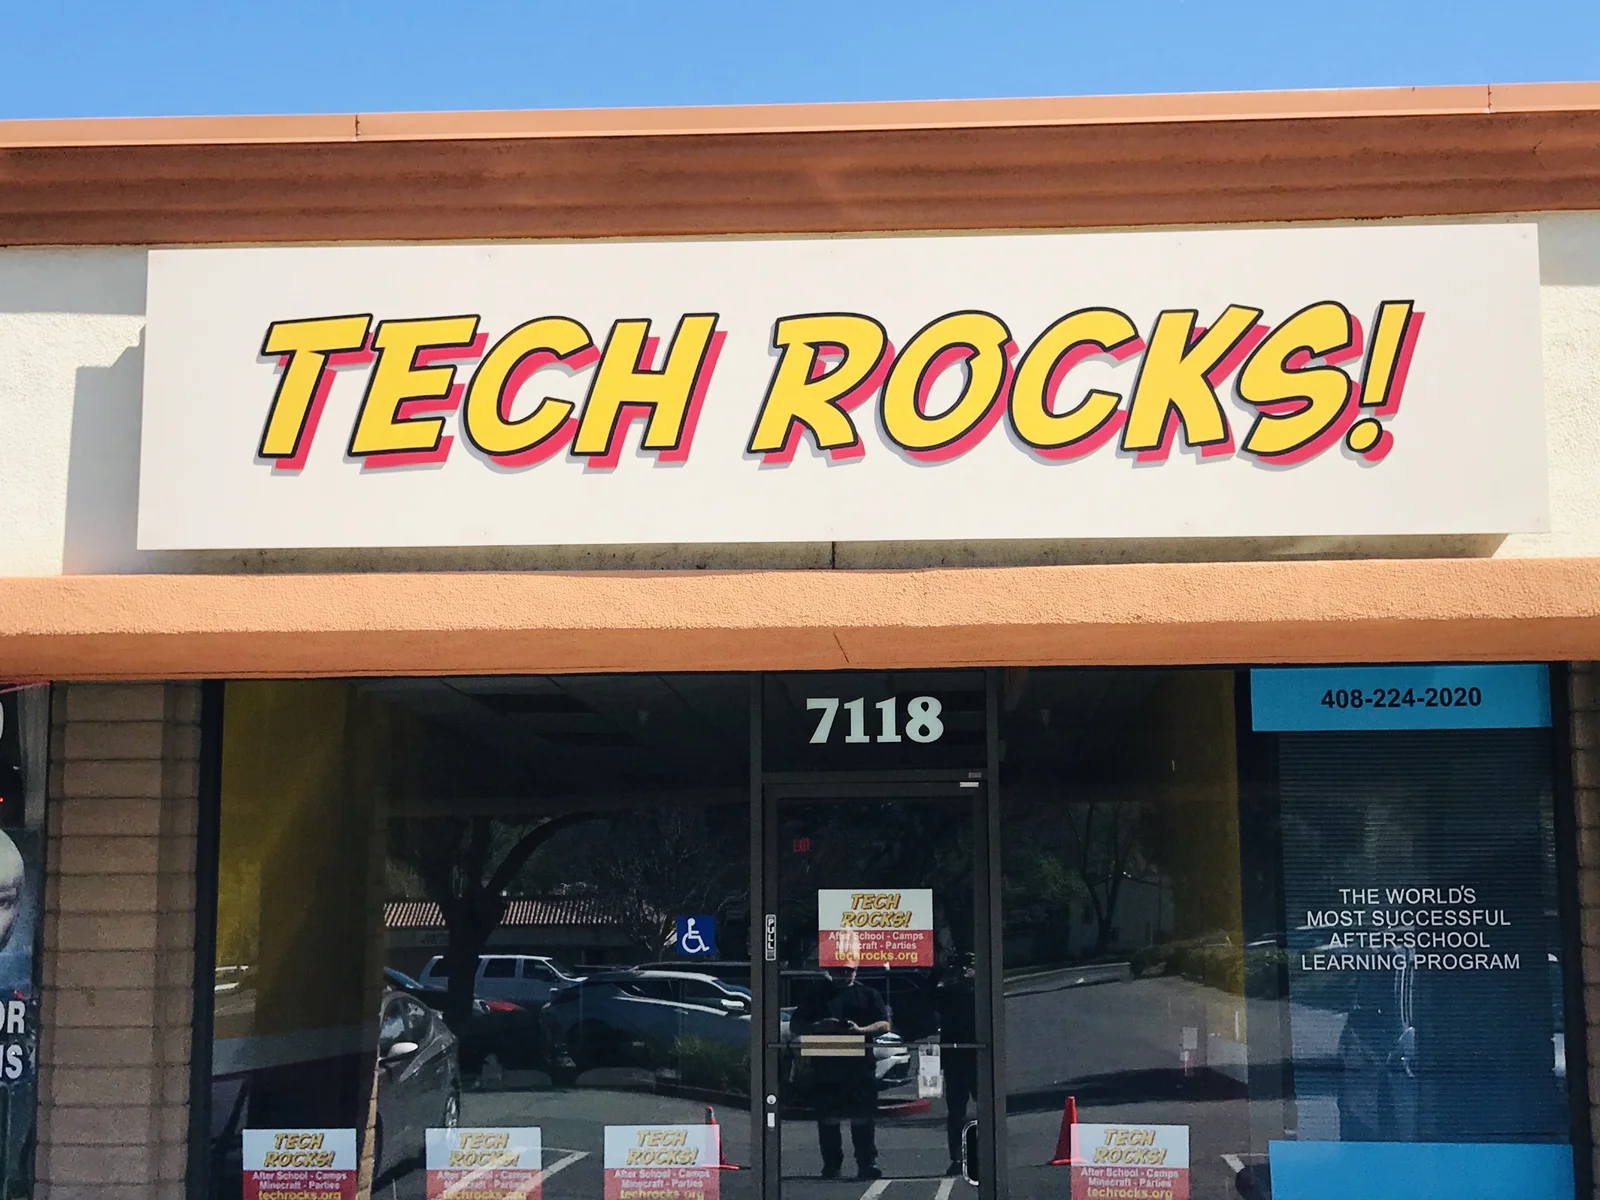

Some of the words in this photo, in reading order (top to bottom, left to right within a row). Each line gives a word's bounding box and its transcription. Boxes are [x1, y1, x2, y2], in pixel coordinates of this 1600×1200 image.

[254, 312, 726, 472] TECH
[743, 299, 1424, 468] ROCKS!
[1320, 686, 1482, 709] 408-224-2020
[806, 695, 944, 743] 7118
[851, 893, 901, 910] TECH
[1339, 888, 1380, 905] THE
[1385, 885, 1477, 904] WORLD'S
[840, 911, 912, 928] ROCKS!
[1306, 910, 1366, 927] MOST
[1371, 909, 1511, 927] SUCCESSFUL
[767, 918, 775, 950] PULL
[828, 931, 852, 940] After
[853, 931, 885, 940] School
[892, 931, 924, 942] Camps
[1328, 931, 1490, 948] AFTER-SCHOOL
[885, 941, 917, 950] Parties
[835, 950, 918, 963] techrocks.org
[1301, 954, 1407, 971] LEARNING
[1414, 953, 1520, 970] PROGRAM
[274, 1133, 325, 1150] TECH
[459, 1133, 510, 1150] TECH
[637, 1129, 688, 1147] TECH
[1104, 1128, 1156, 1146] TECH
[263, 1151, 336, 1168] ROCKS!
[626, 1148, 699, 1165] ROCKS!
[1093, 1147, 1167, 1165] ROCKS!
[252, 1171, 274, 1180] After
[276, 1171, 308, 1180] School
[315, 1171, 347, 1181] Camps
[614, 1169, 636, 1178] After
[639, 1169, 671, 1178] School
[1081, 1167, 1103, 1176] After
[1106, 1168, 1139, 1177] School
[1146, 1169, 1179, 1180] Camps
[259, 1181, 301, 1189] Minecraft
[309, 1181, 340, 1189] Parties
[671, 1179, 703, 1188] Parties
[1139, 1178, 1172, 1188] Parties
[258, 1191, 341, 1200] techrocks.org
[620, 1189, 704, 1200] techrocks.org
[1087, 1187, 1173, 1200] techrocks.org
